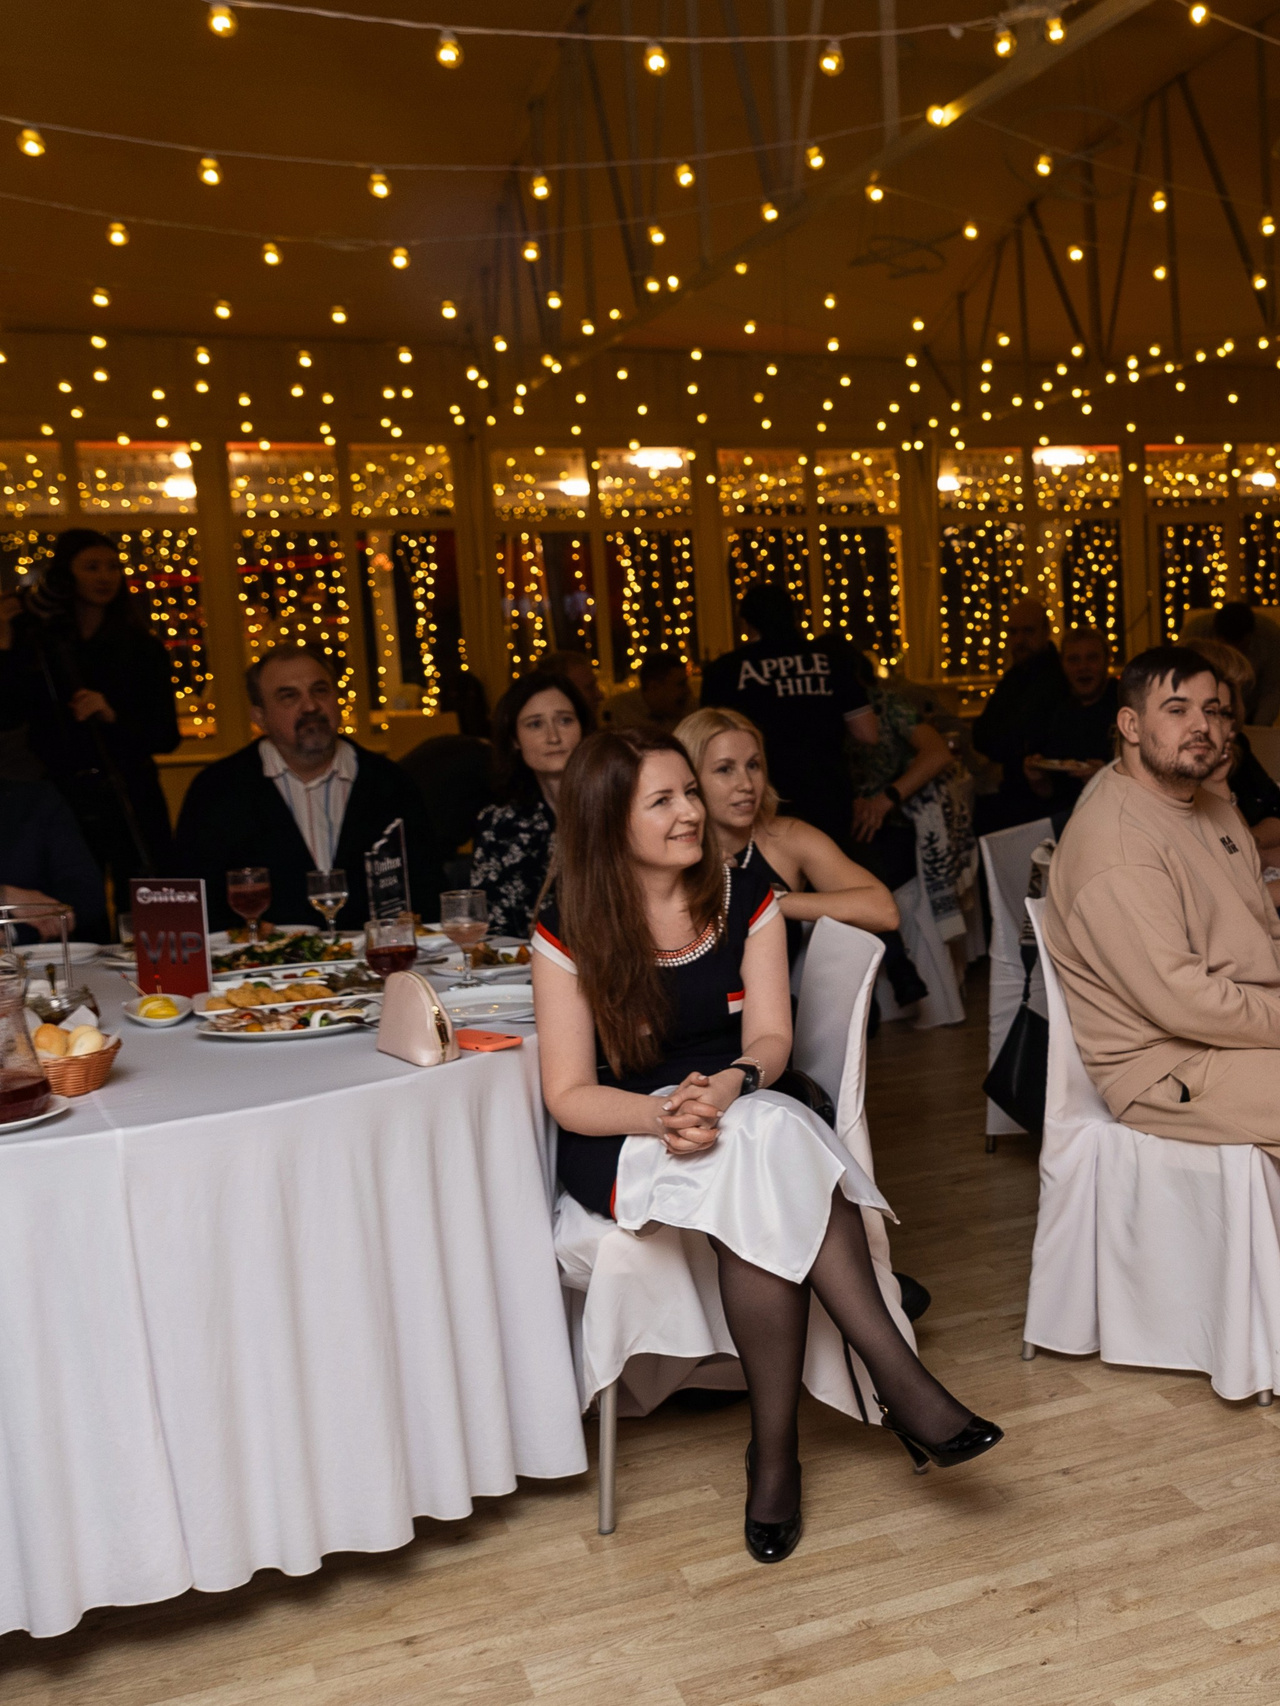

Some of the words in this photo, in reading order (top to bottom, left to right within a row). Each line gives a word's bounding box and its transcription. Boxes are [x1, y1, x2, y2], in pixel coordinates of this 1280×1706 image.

[737, 653, 831, 690] APPLE
[775, 676, 833, 697] HILL
[139, 931, 202, 964] VIP
